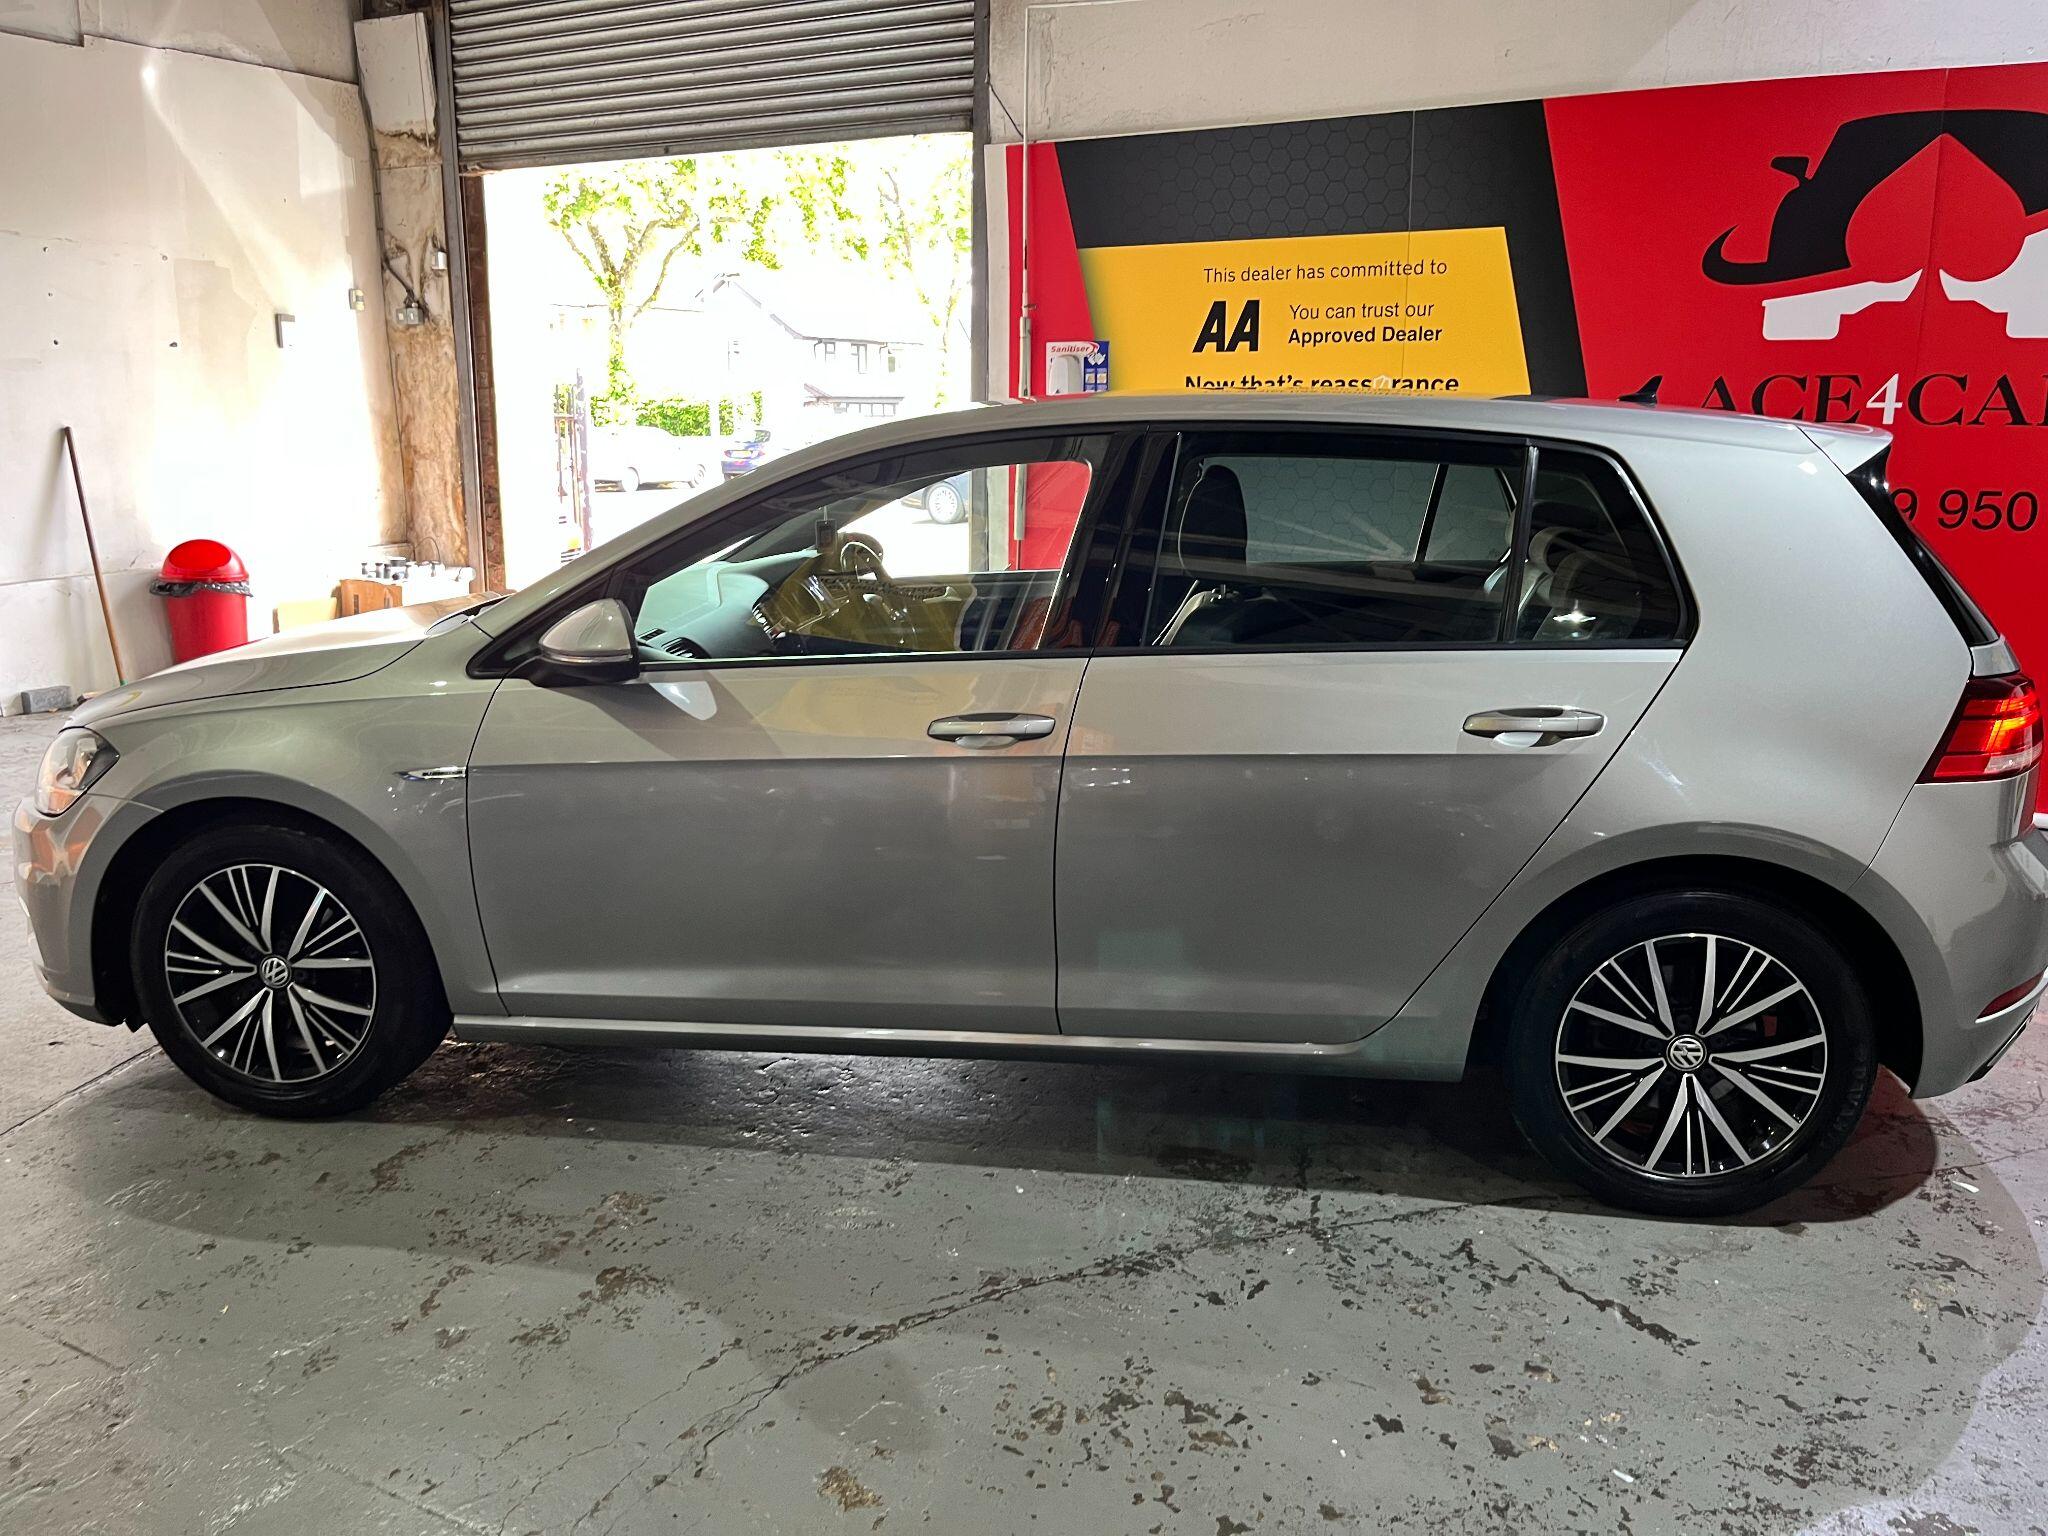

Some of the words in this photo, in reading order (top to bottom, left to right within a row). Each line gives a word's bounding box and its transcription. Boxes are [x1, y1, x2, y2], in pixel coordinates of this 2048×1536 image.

[1203, 267, 1236, 283] This
[1241, 265, 1292, 282] dealer
[1297, 264, 1325, 279] has
[1330, 260, 1424, 278] committed
[1430, 259, 1447, 275] to
[1289, 304, 1319, 320] You
[1325, 304, 1356, 319] can
[1362, 302, 1400, 318] trust
[1405, 303, 1435, 317] our
[1192, 299, 1260, 353] AA
[1288, 326, 1376, 347] Approved
[1382, 325, 1443, 342] Dealer
[1051, 345, 1090, 353] Sanitiser
[1701, 373, 2048, 426] ACE4CA
[1938, 489, 2038, 532] 950
